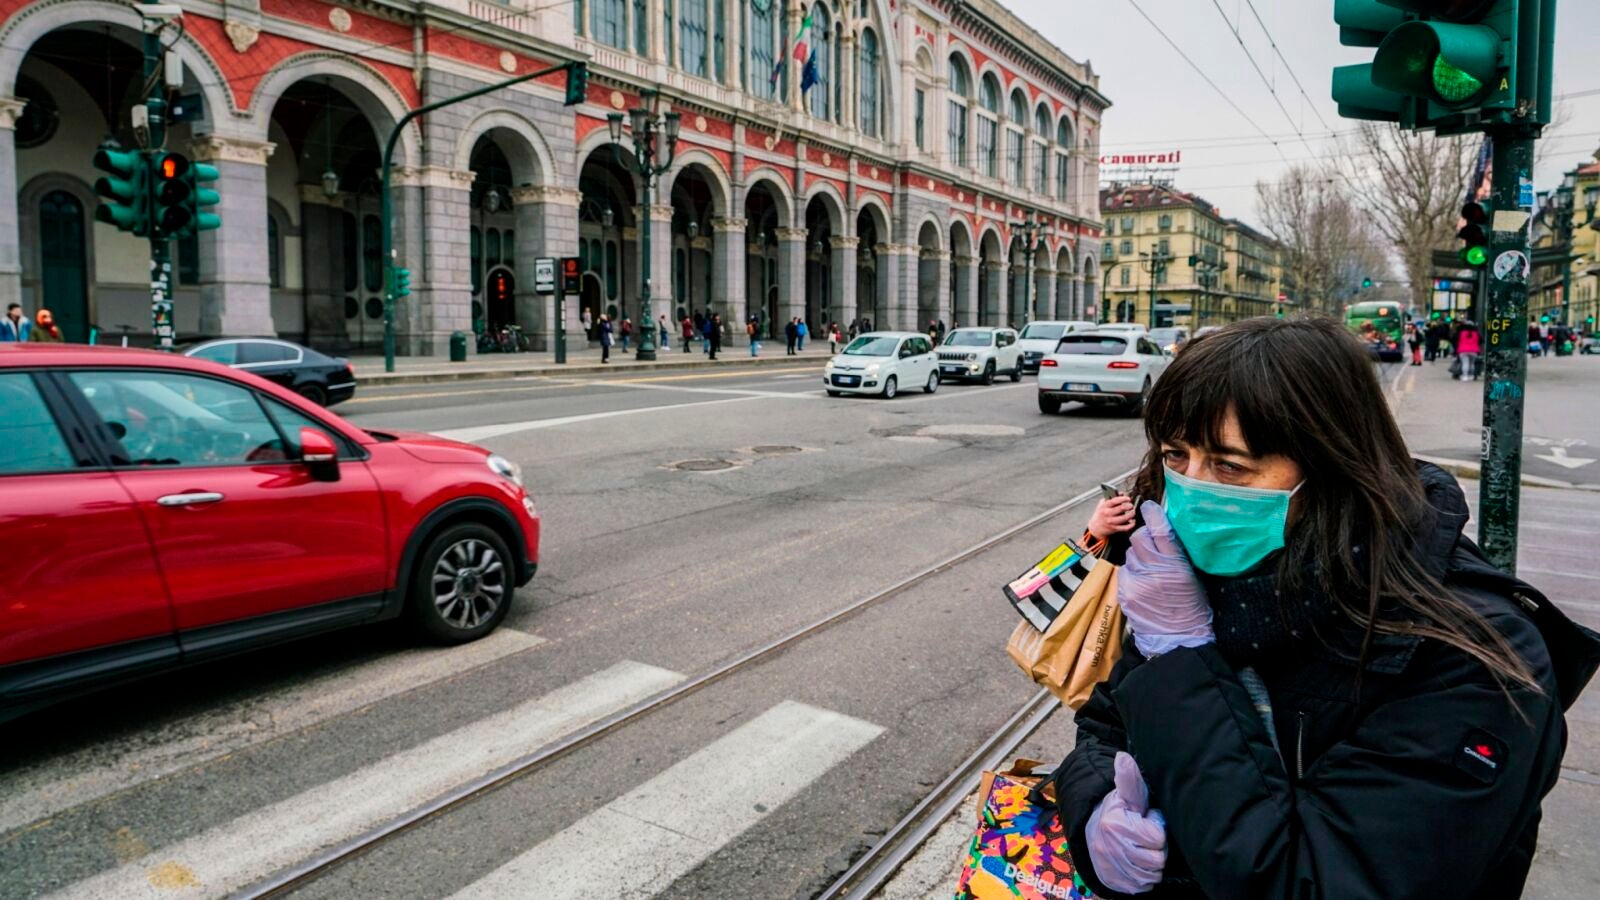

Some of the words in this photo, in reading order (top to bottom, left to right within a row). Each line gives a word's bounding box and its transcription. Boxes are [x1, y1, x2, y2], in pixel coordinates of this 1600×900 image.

[1499, 77, 1509, 91] A
[1100, 150, 1180, 163] camurati
[1491, 332, 1500, 345] 6
[1091, 604, 1113, 668] bershka.com
